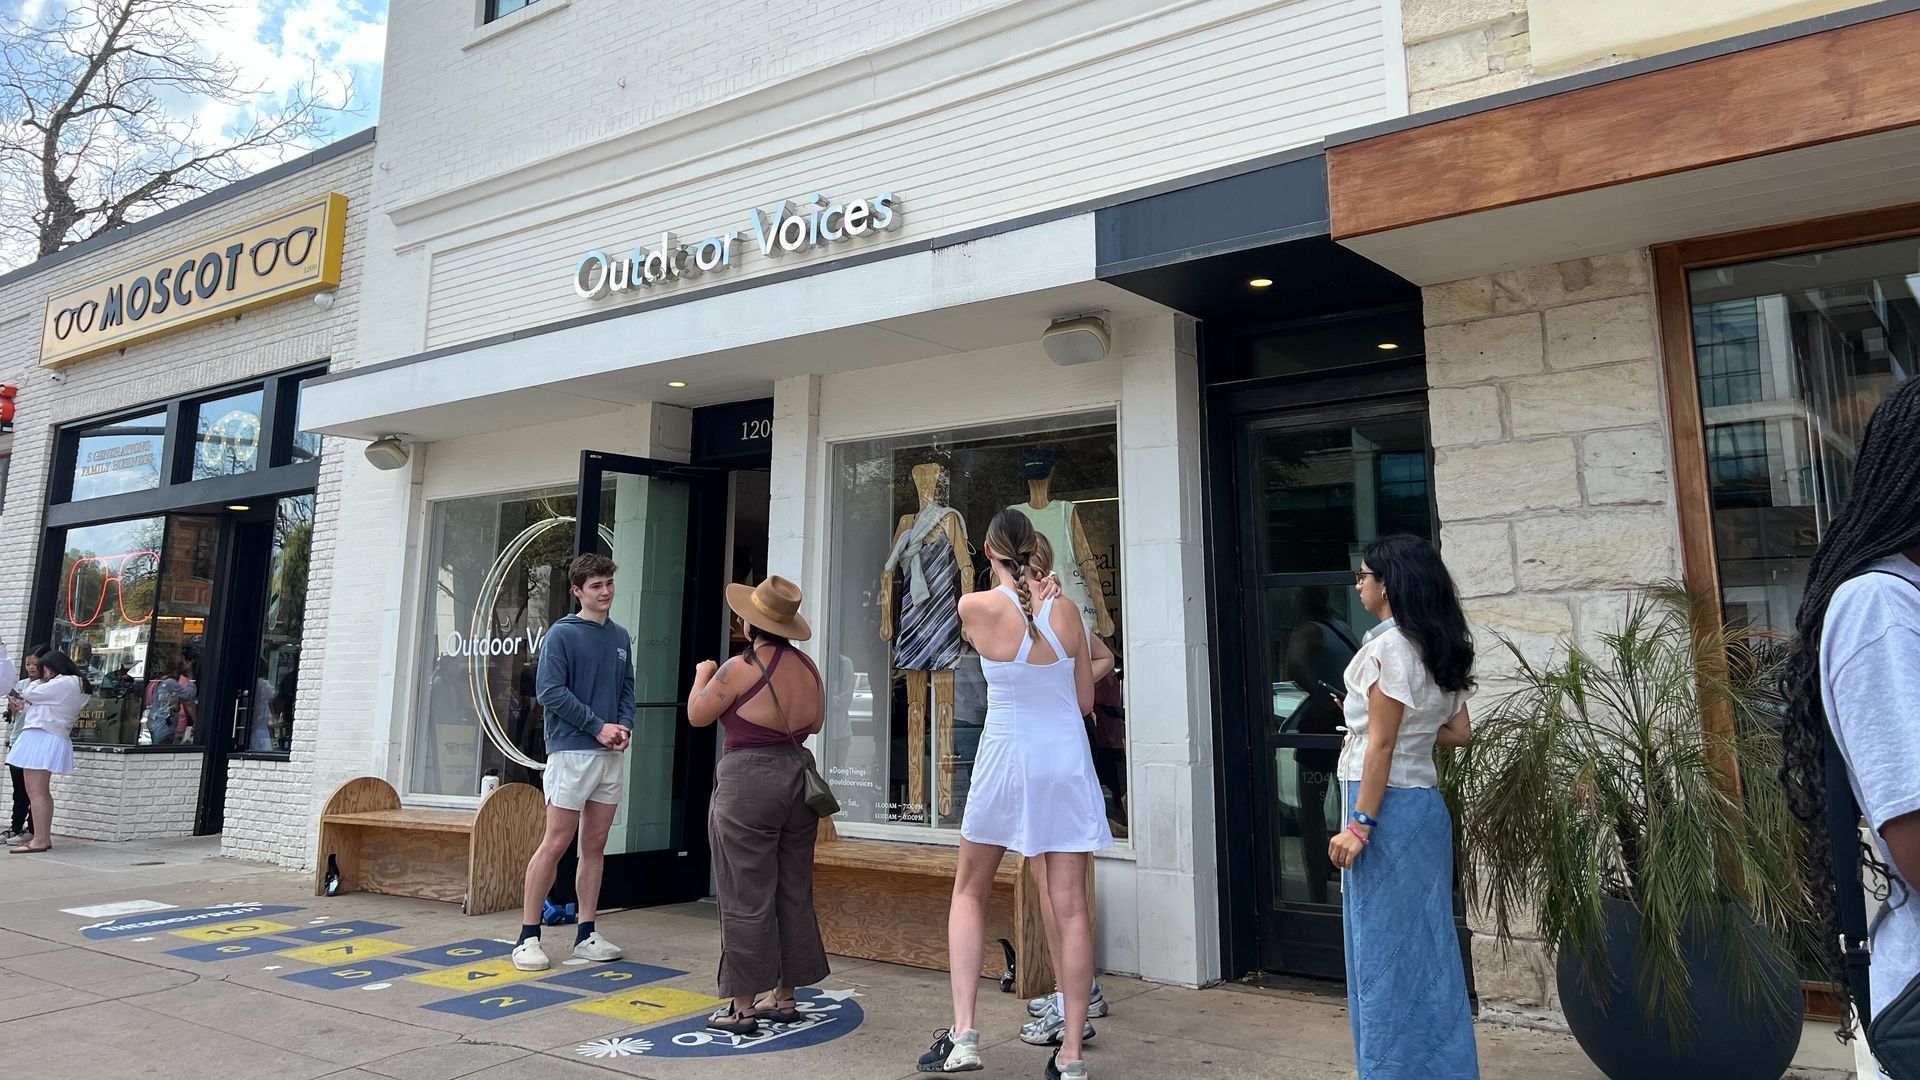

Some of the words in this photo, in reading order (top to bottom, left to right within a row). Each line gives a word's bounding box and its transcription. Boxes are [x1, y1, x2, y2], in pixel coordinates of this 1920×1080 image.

[573, 231, 744, 300] Outdoor
[751, 192, 900, 257] Voices
[98, 242, 244, 332] MOSCOT
[81, 461, 111, 477] FAMILY
[447, 630, 522, 658] Outdoor
[206, 925, 261, 935] 10
[330, 968, 373, 979] 5
[467, 971, 499, 981] 4
[590, 970, 633, 981] 3
[479, 996, 528, 1008] 2
[629, 1000, 667, 1008] 1
